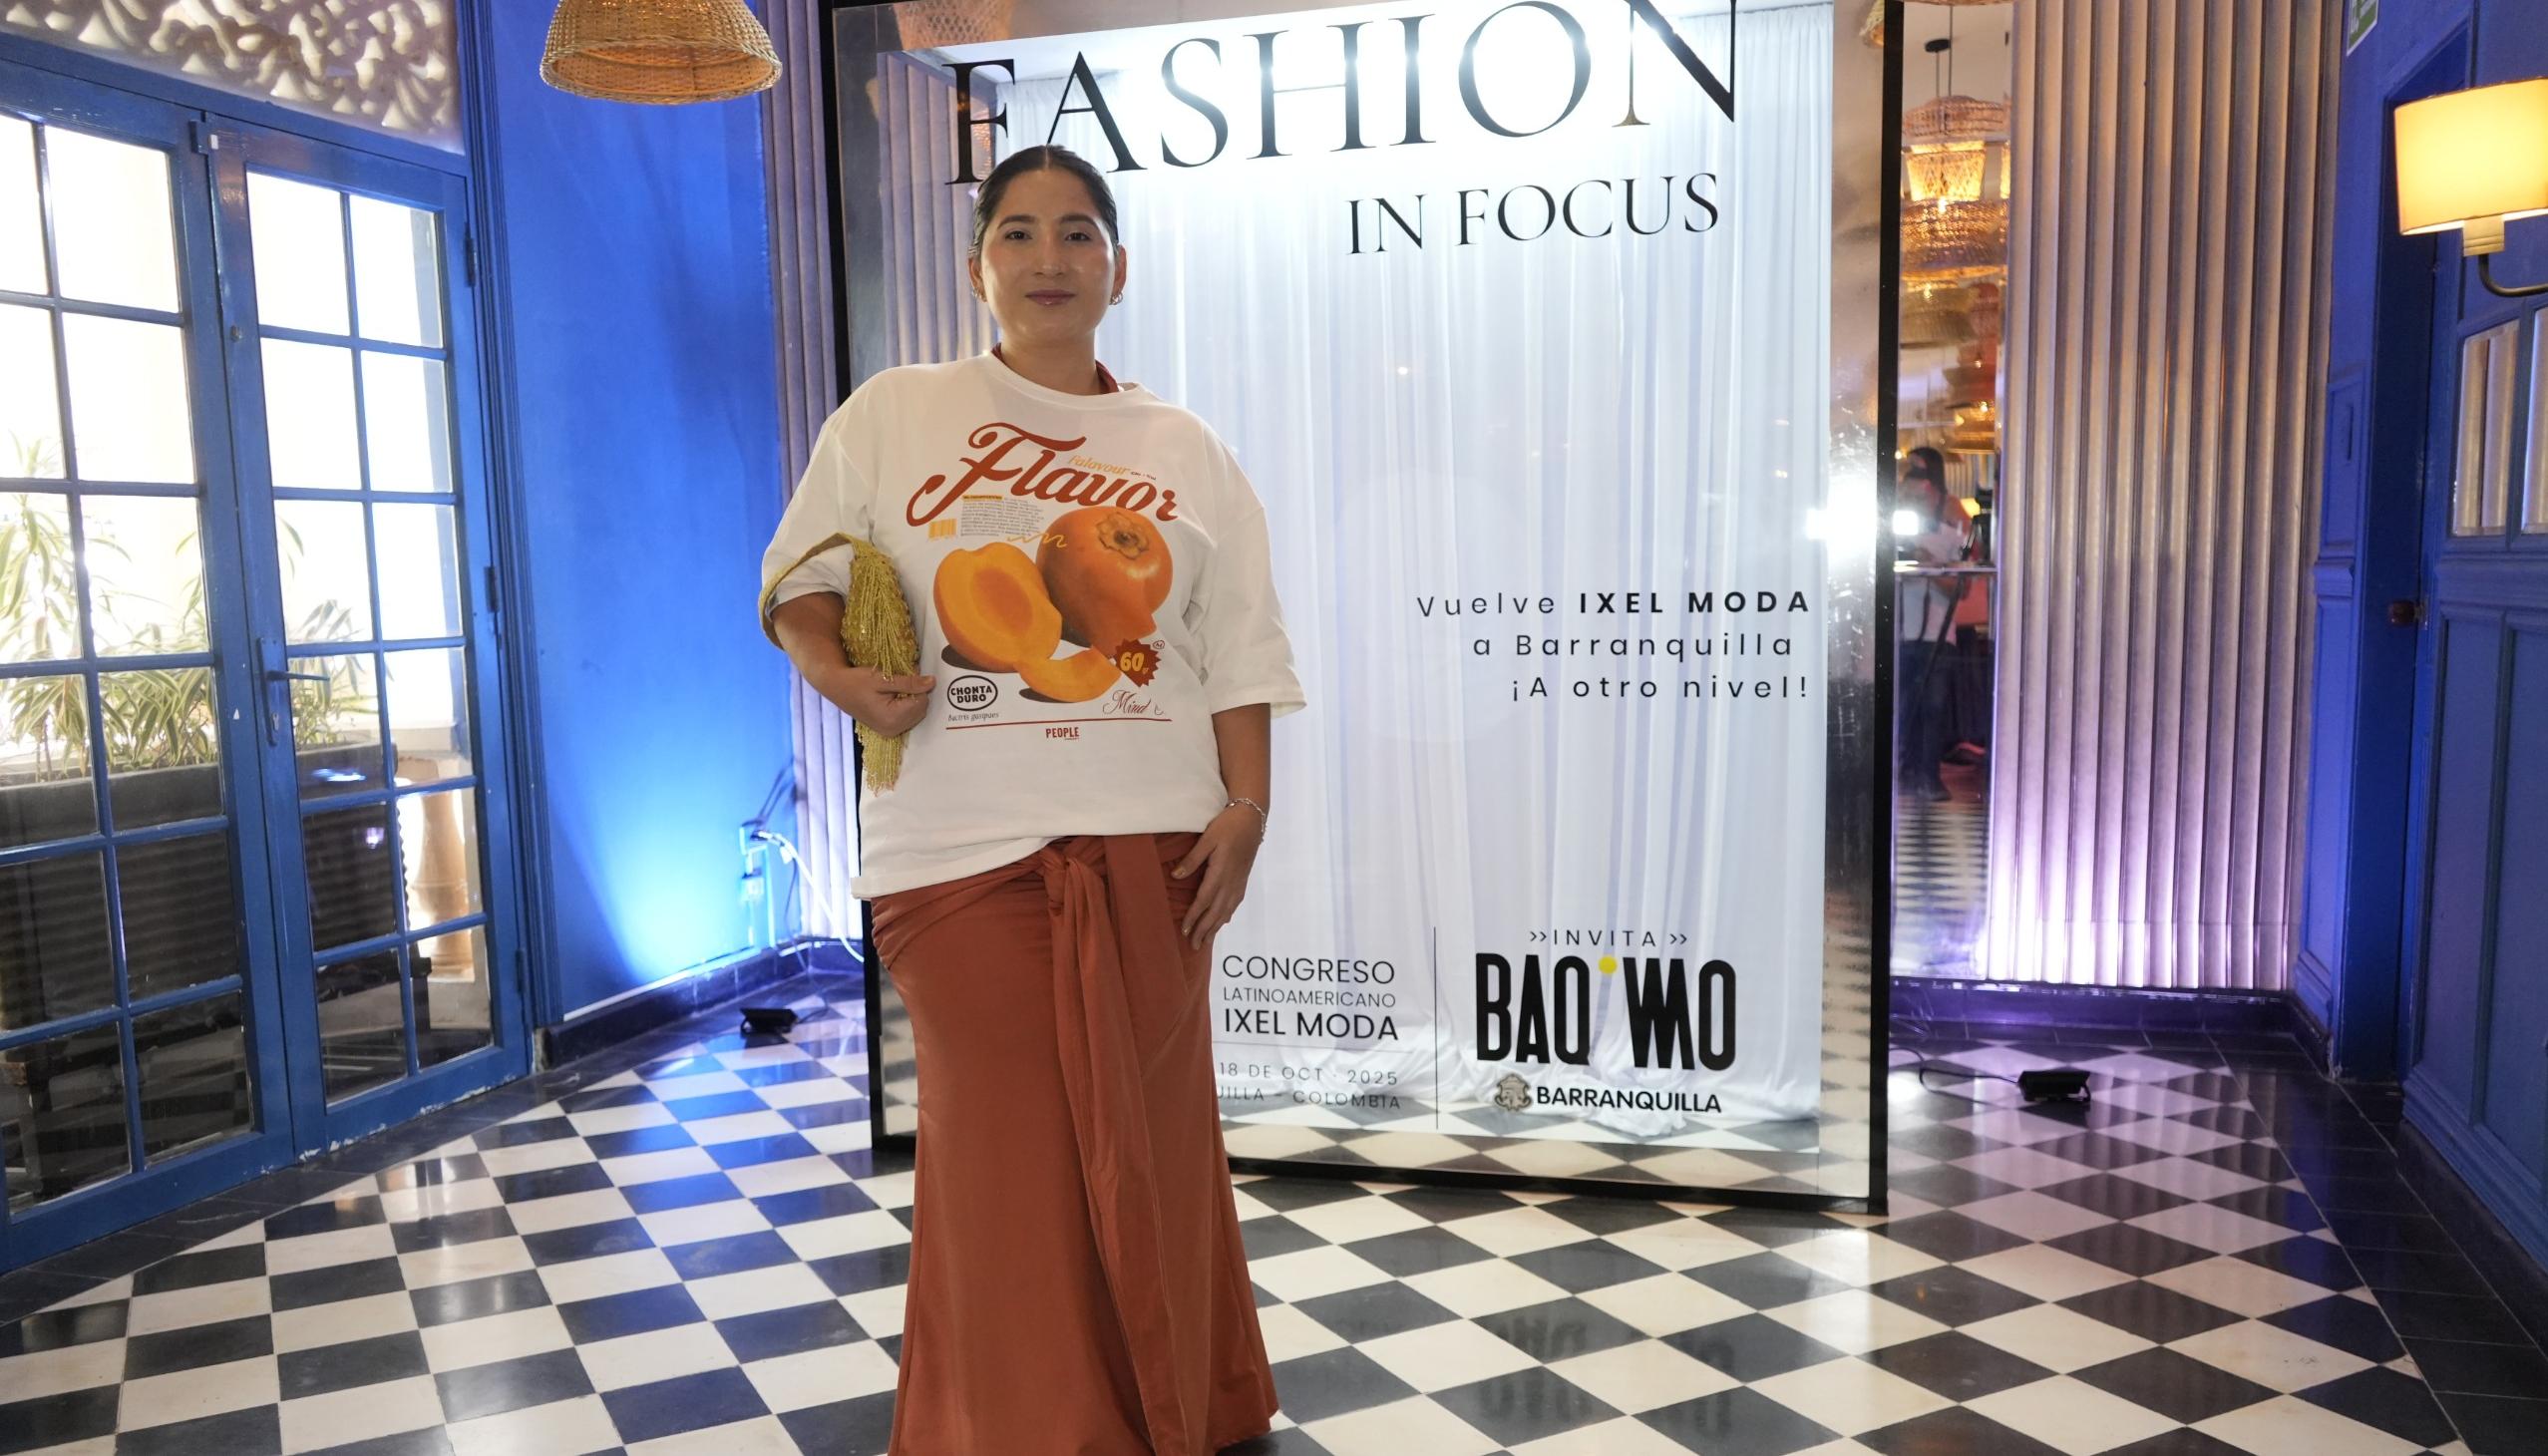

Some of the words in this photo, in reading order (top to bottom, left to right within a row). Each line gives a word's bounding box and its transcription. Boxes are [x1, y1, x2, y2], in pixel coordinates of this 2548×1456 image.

[940, 0, 1737, 186] FASHION
[1345, 193, 1428, 255] IN
[1454, 172, 1718, 246] FOCUS
[906, 421, 1179, 528] Flavor
[1416, 591, 1555, 617] Vuelve
[1579, 591, 1663, 614] IXEL
[1687, 589, 1810, 613] MODA
[1473, 637, 1491, 656] a
[1516, 633, 1792, 662] Barranquilla
[1120, 651, 1145, 672] 60
[950, 685, 992, 696] CHONTA
[956, 694, 986, 703] DURO
[1513, 676, 1548, 701] ¡A
[1573, 676, 1657, 698] otro
[1683, 675, 1807, 698] nivel!
[1045, 727, 1080, 739] PEOPLE
[1223, 954, 1395, 984] CONGRESO
[1224, 985, 1397, 1008] LATINOAMERICANO
[1225, 1007, 1286, 1035] IXEL
[1296, 1011, 1399, 1041] MODA
[1220, 1061, 1238, 1077] 18
[1249, 1063, 1272, 1079] DE
[1281, 1066, 1323, 1081] OCT
[1347, 1069, 1398, 1086] 2025
[1292, 1090, 1401, 1110] COLOMBIA
[1536, 1086, 1722, 1114] BARRANQUILLA
